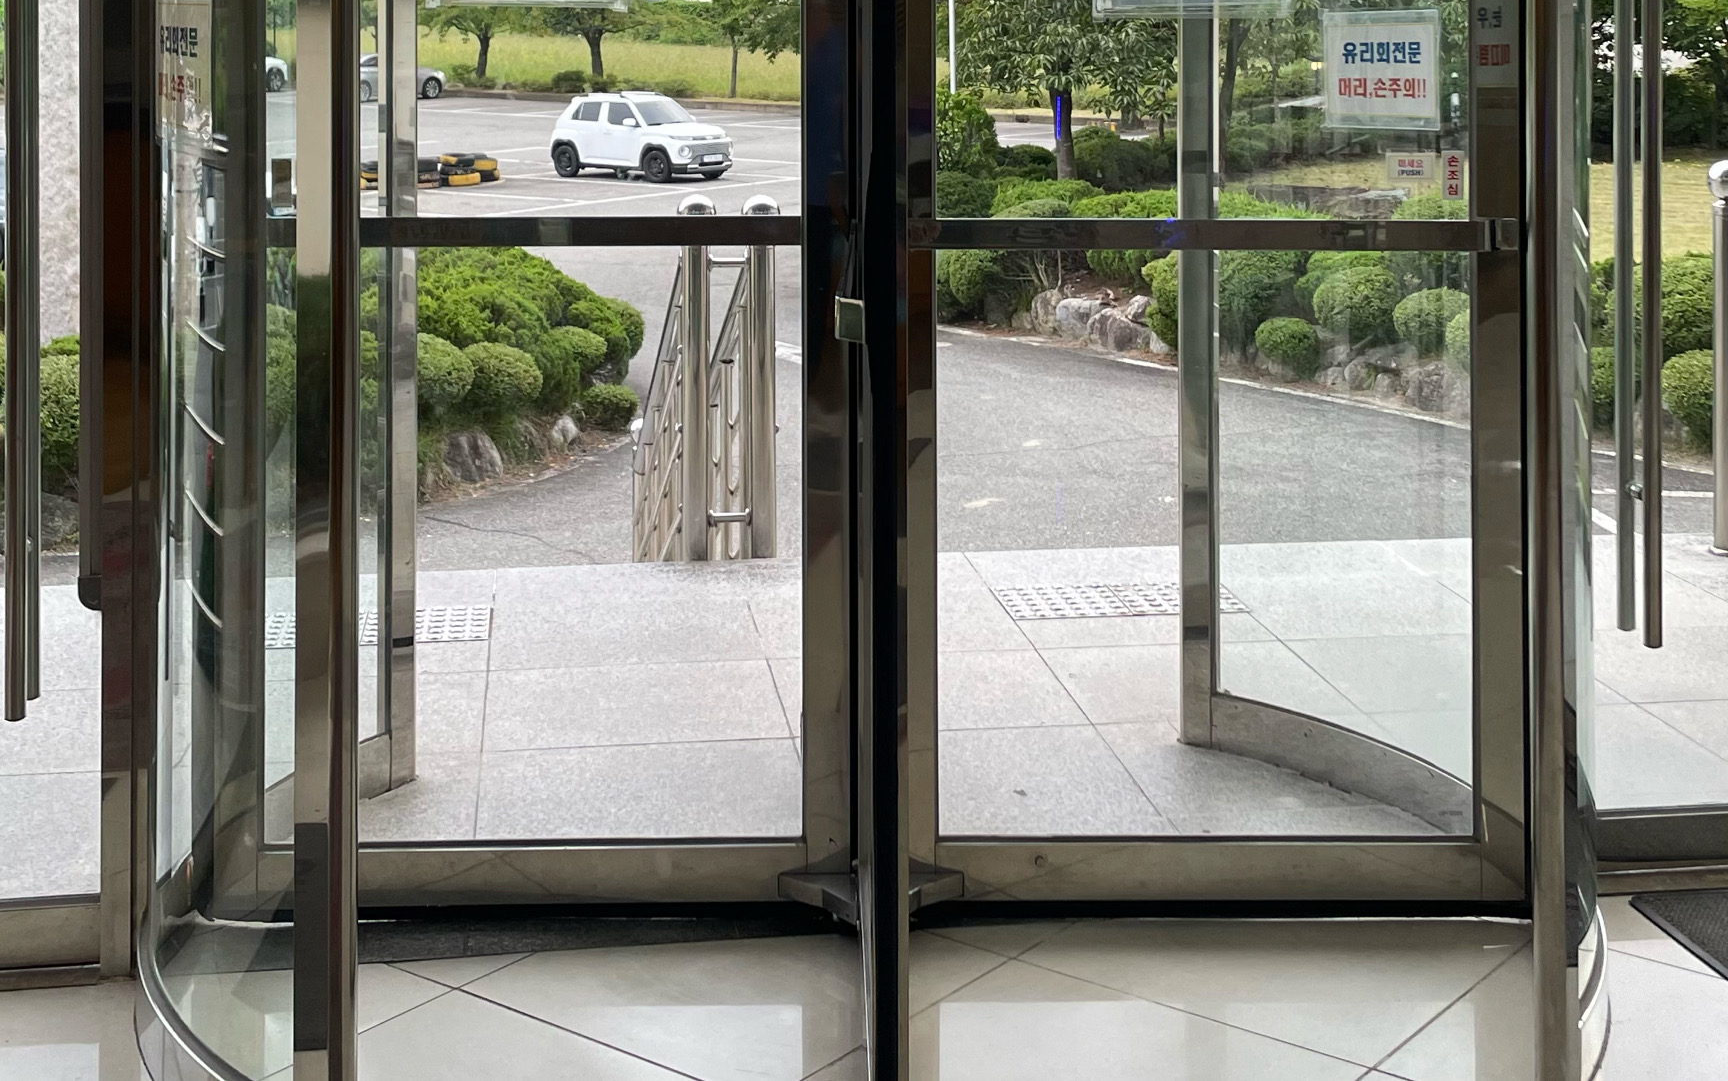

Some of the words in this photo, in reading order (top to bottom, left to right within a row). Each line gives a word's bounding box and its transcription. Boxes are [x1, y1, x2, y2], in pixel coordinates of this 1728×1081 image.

[159, 25, 198, 57] 유리회전문
[1342, 41, 1421, 64] 유리회전문
[1338, 78, 1427, 99] 머리,손주의!!
[1447, 155, 1460, 195] 손조심
